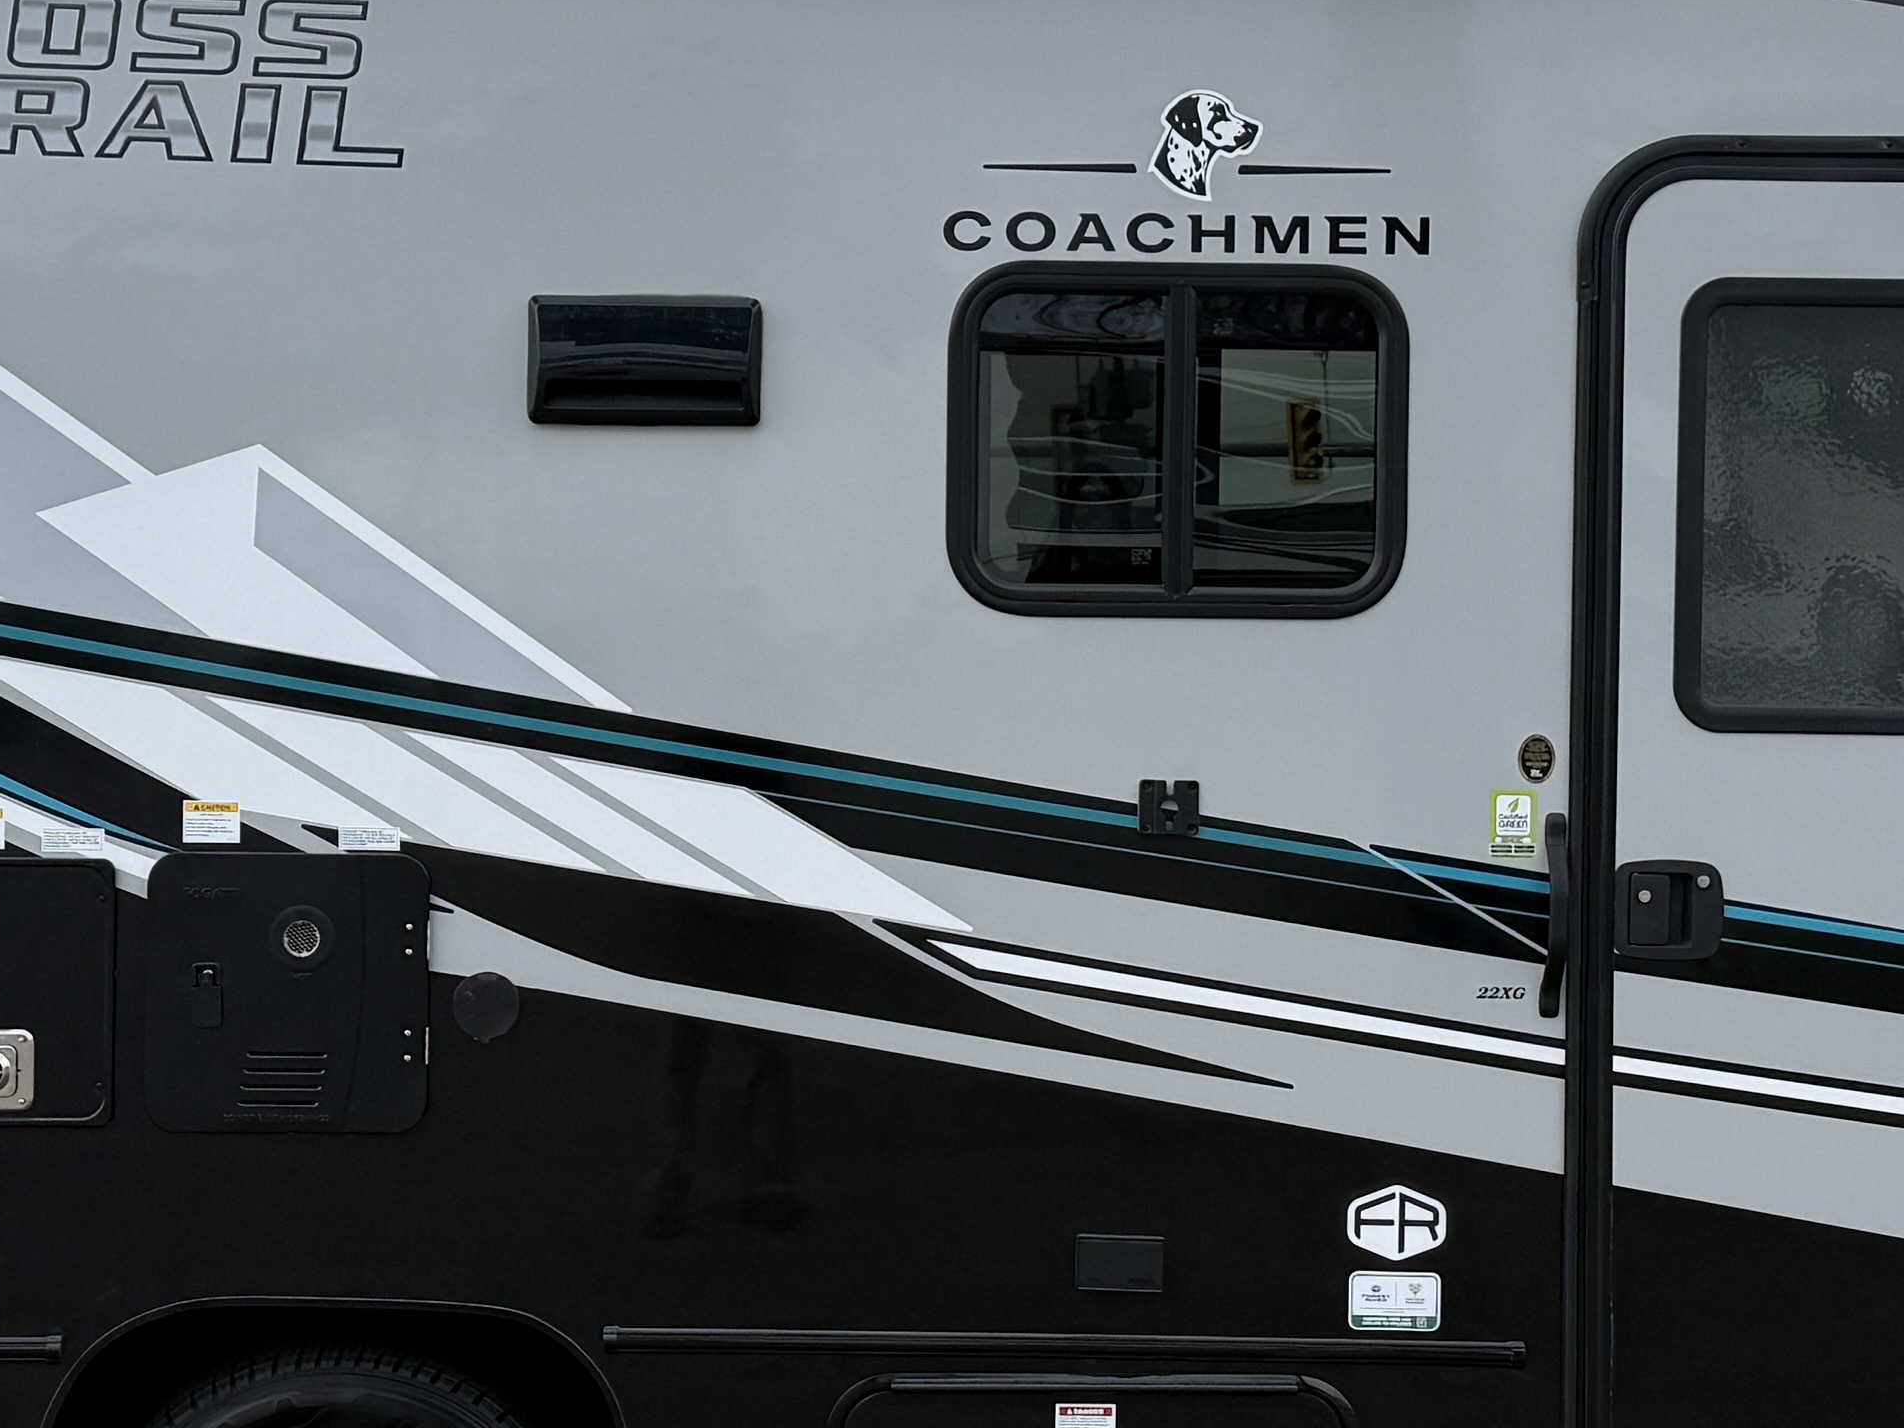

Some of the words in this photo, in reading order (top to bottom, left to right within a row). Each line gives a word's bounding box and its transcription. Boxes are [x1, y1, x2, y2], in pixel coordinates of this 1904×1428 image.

[942, 210, 1431, 256] COACHMEN
[1498, 819, 1528, 829] GREEN
[1475, 986, 1526, 1000] 22XG
[1354, 1191, 1440, 1254] FR
